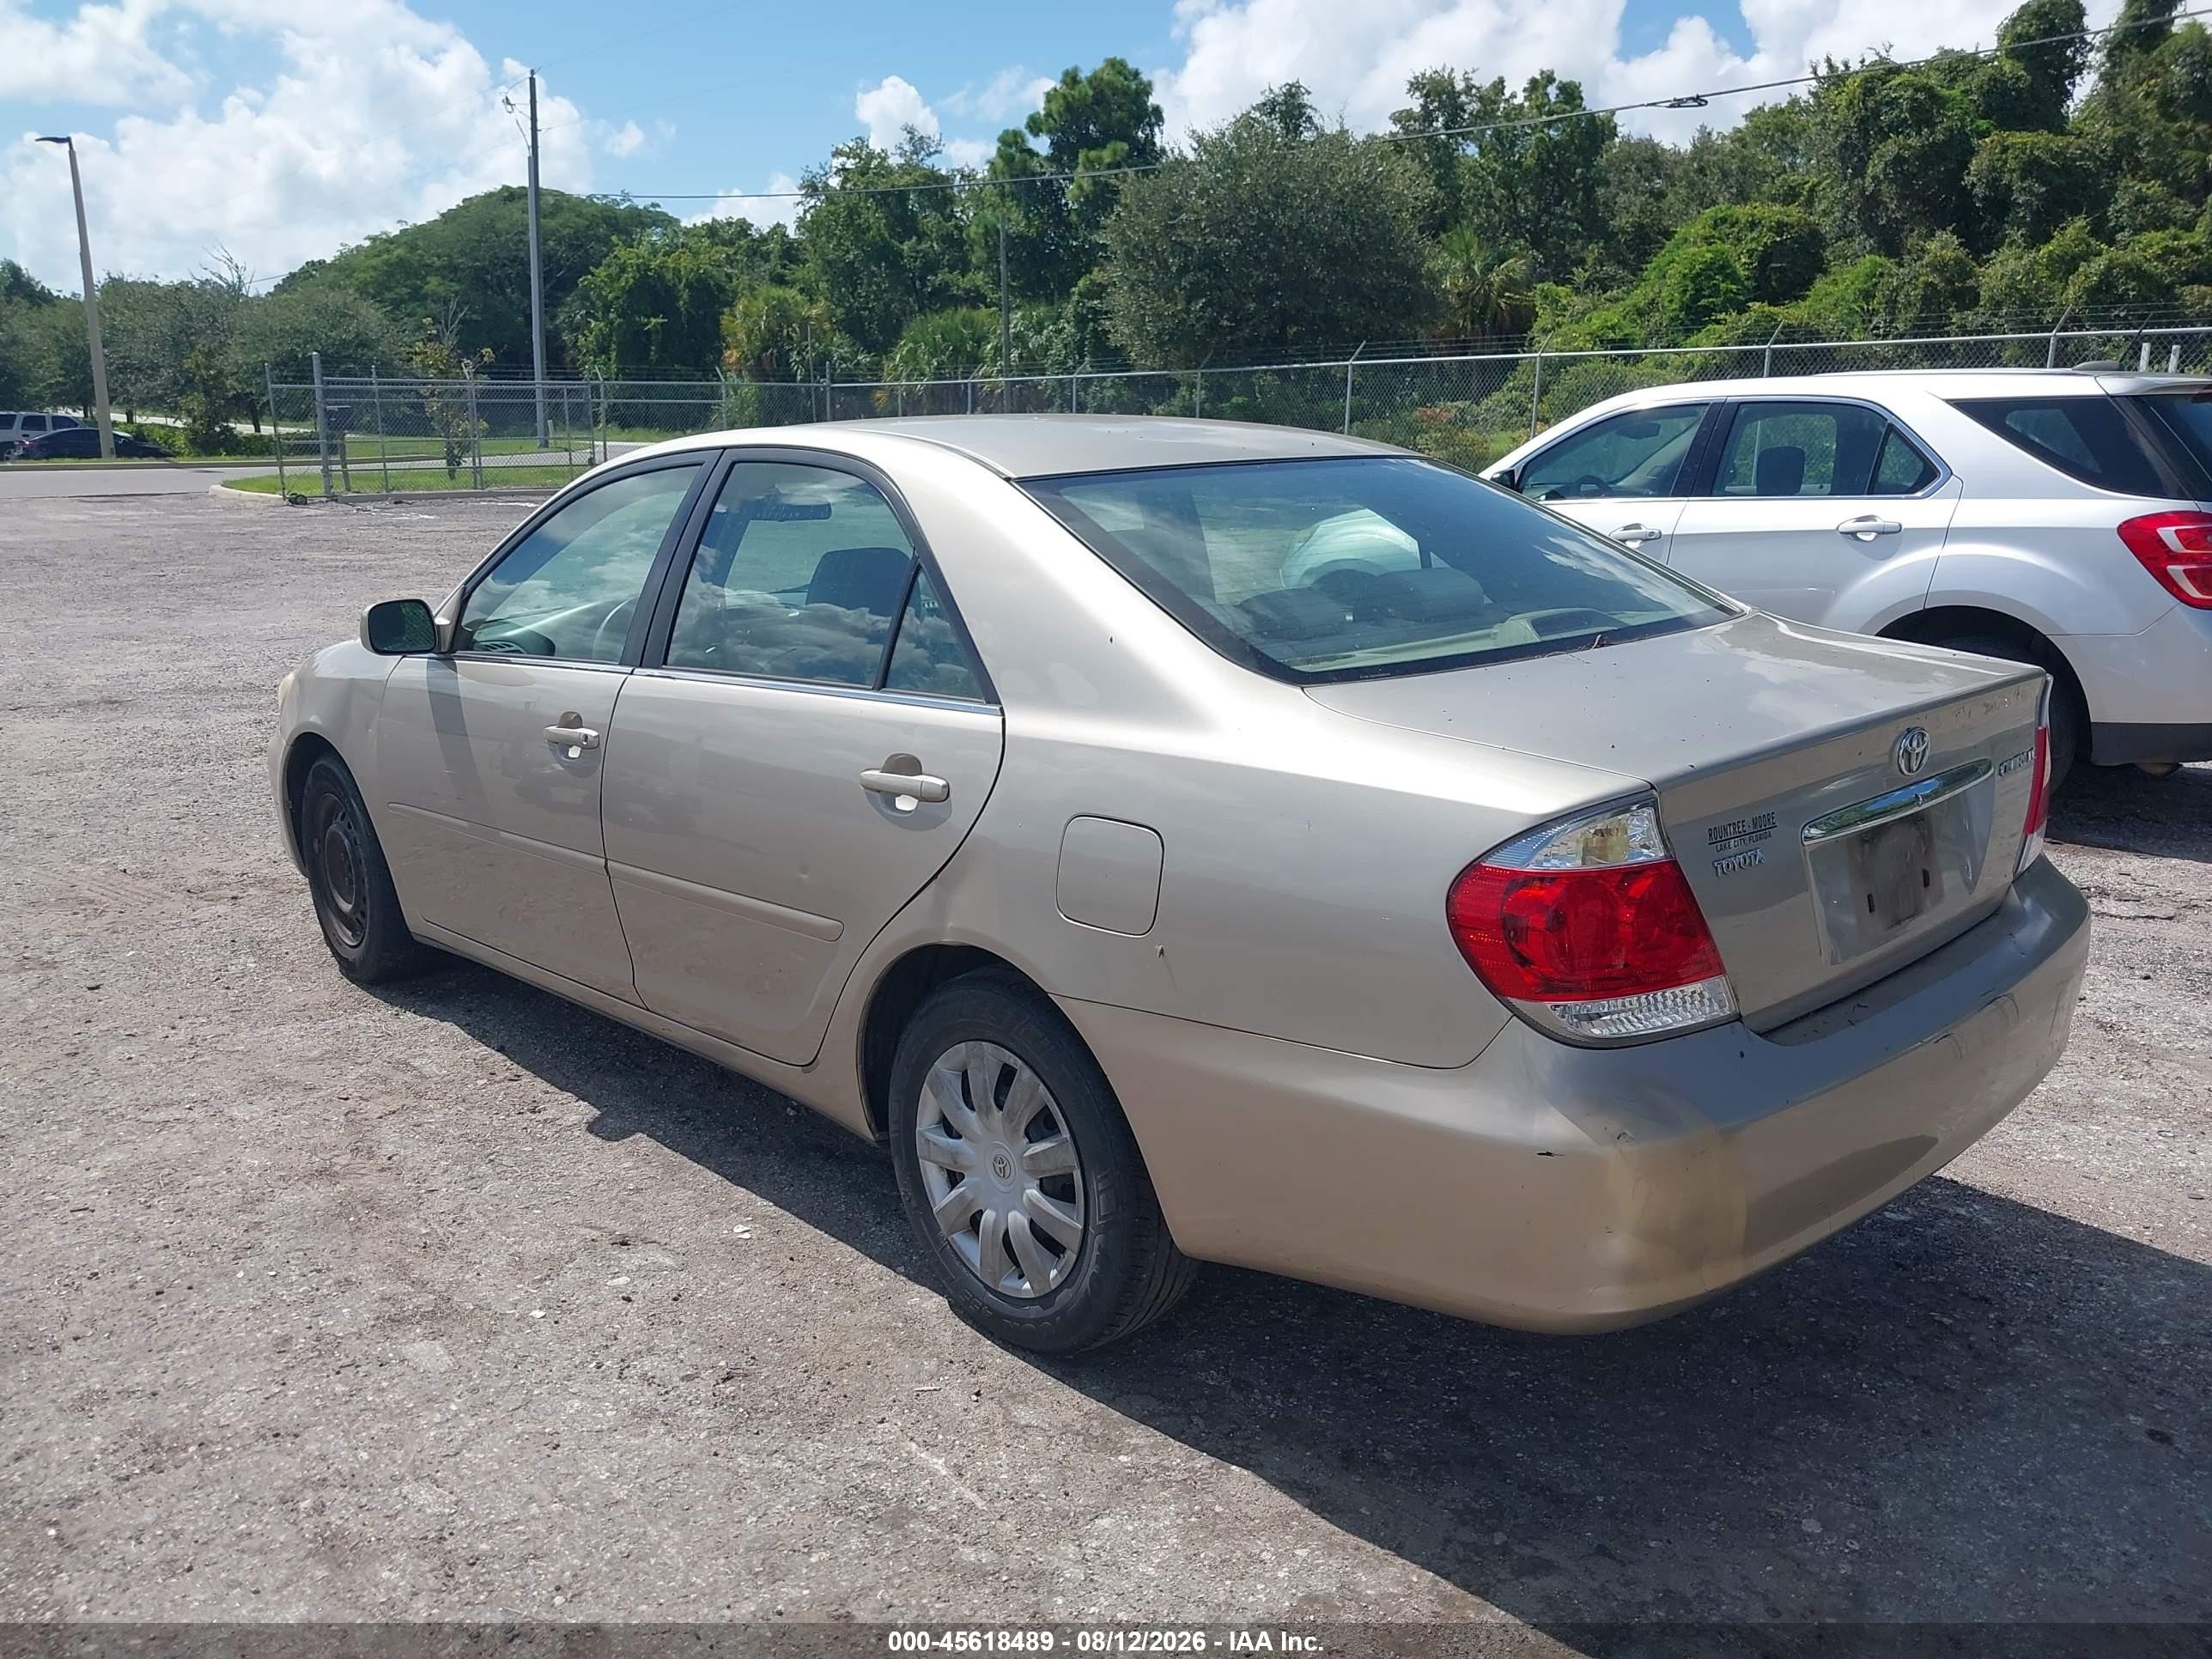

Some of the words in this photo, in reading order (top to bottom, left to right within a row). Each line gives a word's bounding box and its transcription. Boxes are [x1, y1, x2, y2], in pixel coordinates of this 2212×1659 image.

[1708, 819, 1747, 842] ROUNTREE
[1752, 811, 1776, 830] MOORE
[1716, 842, 1732, 853] LAKE
[1748, 830, 1771, 843] FLORIDA
[1712, 848, 1765, 877] TOYOTA
